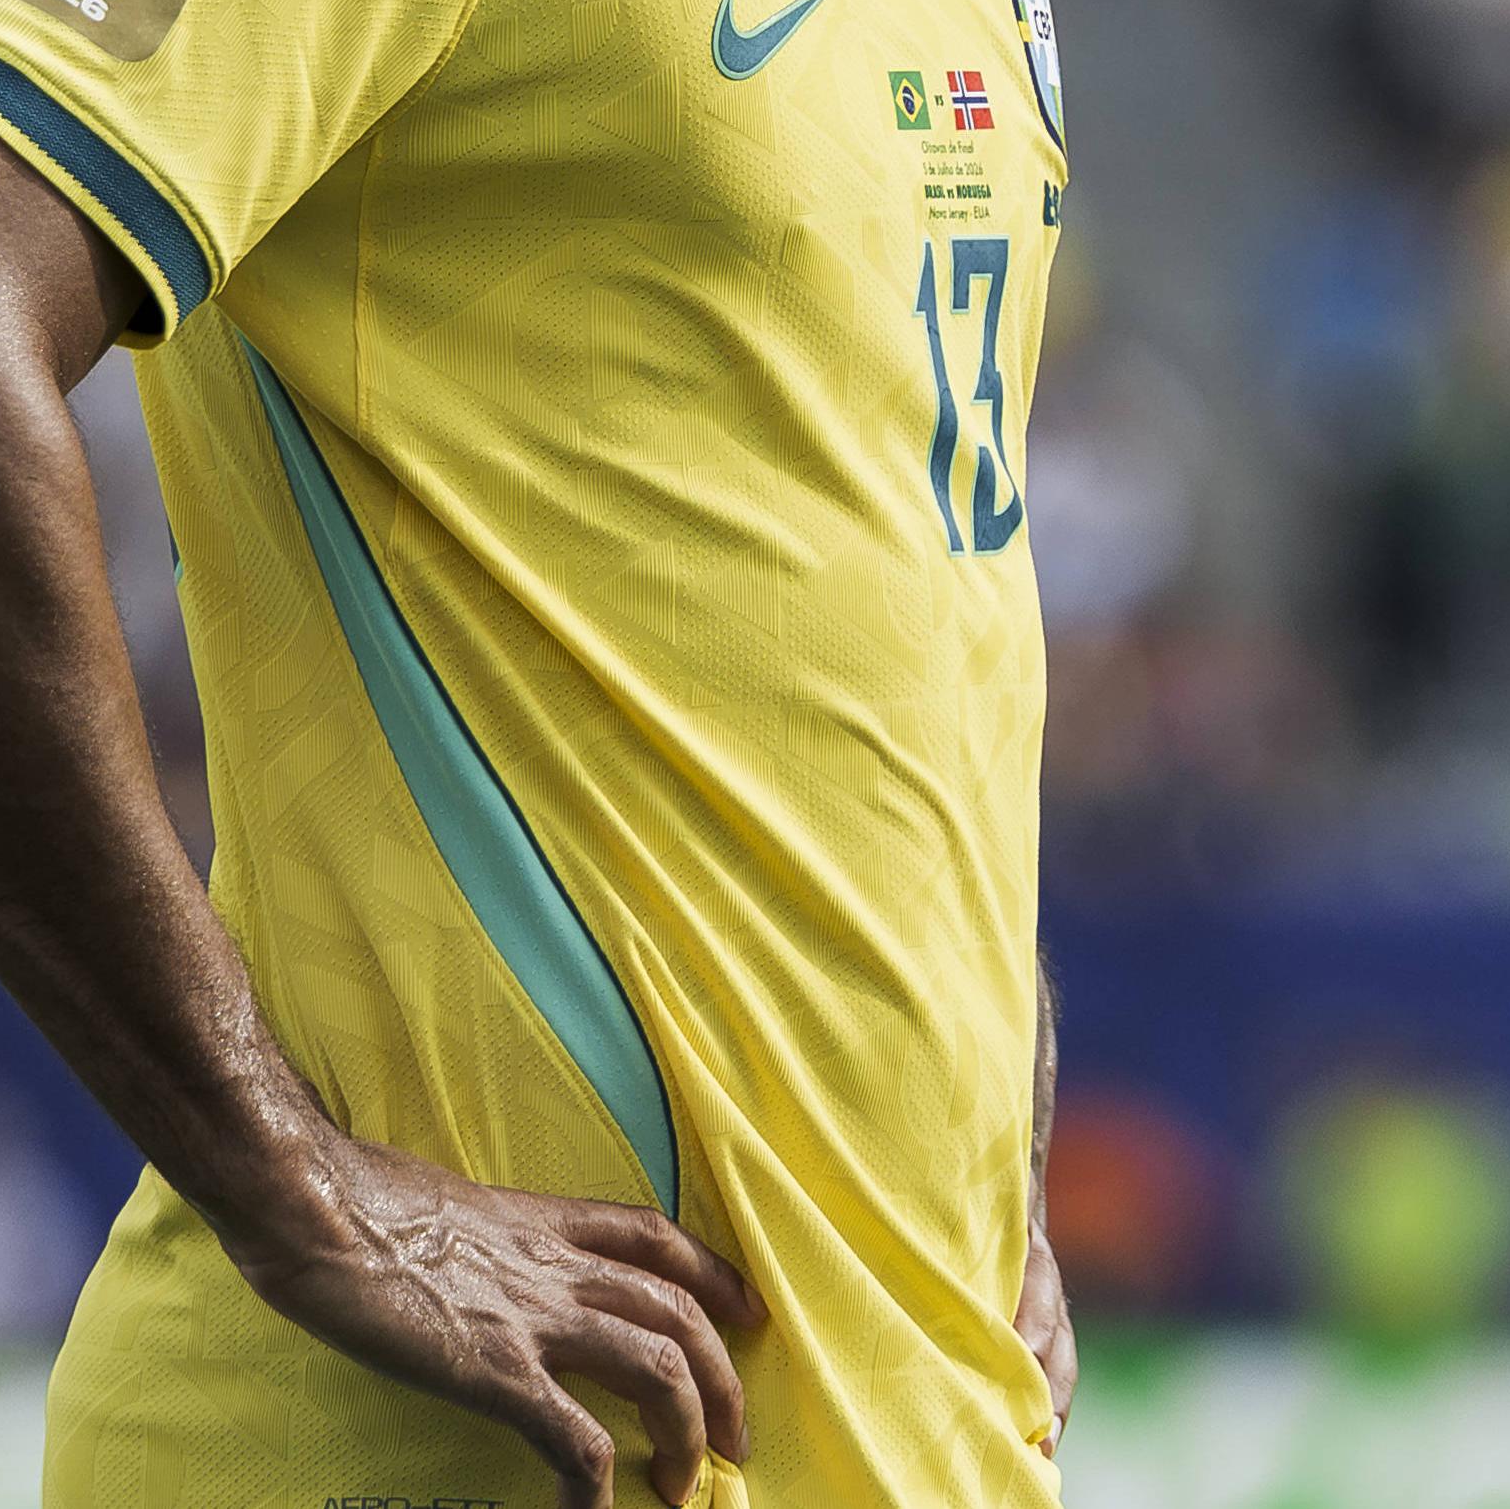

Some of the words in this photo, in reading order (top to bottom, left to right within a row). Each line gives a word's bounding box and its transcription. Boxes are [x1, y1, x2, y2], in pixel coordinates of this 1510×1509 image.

[1033, 9, 1051, 40] CB
[955, 162, 964, 175] de
[964, 162, 984, 175] 2026
[924, 184, 946, 199] BRASIL
[947, 188, 955, 199] vs
[956, 184, 991, 199] NORUEGA
[973, 205, 991, 219] EUA
[912, 233, 1025, 557] 13
